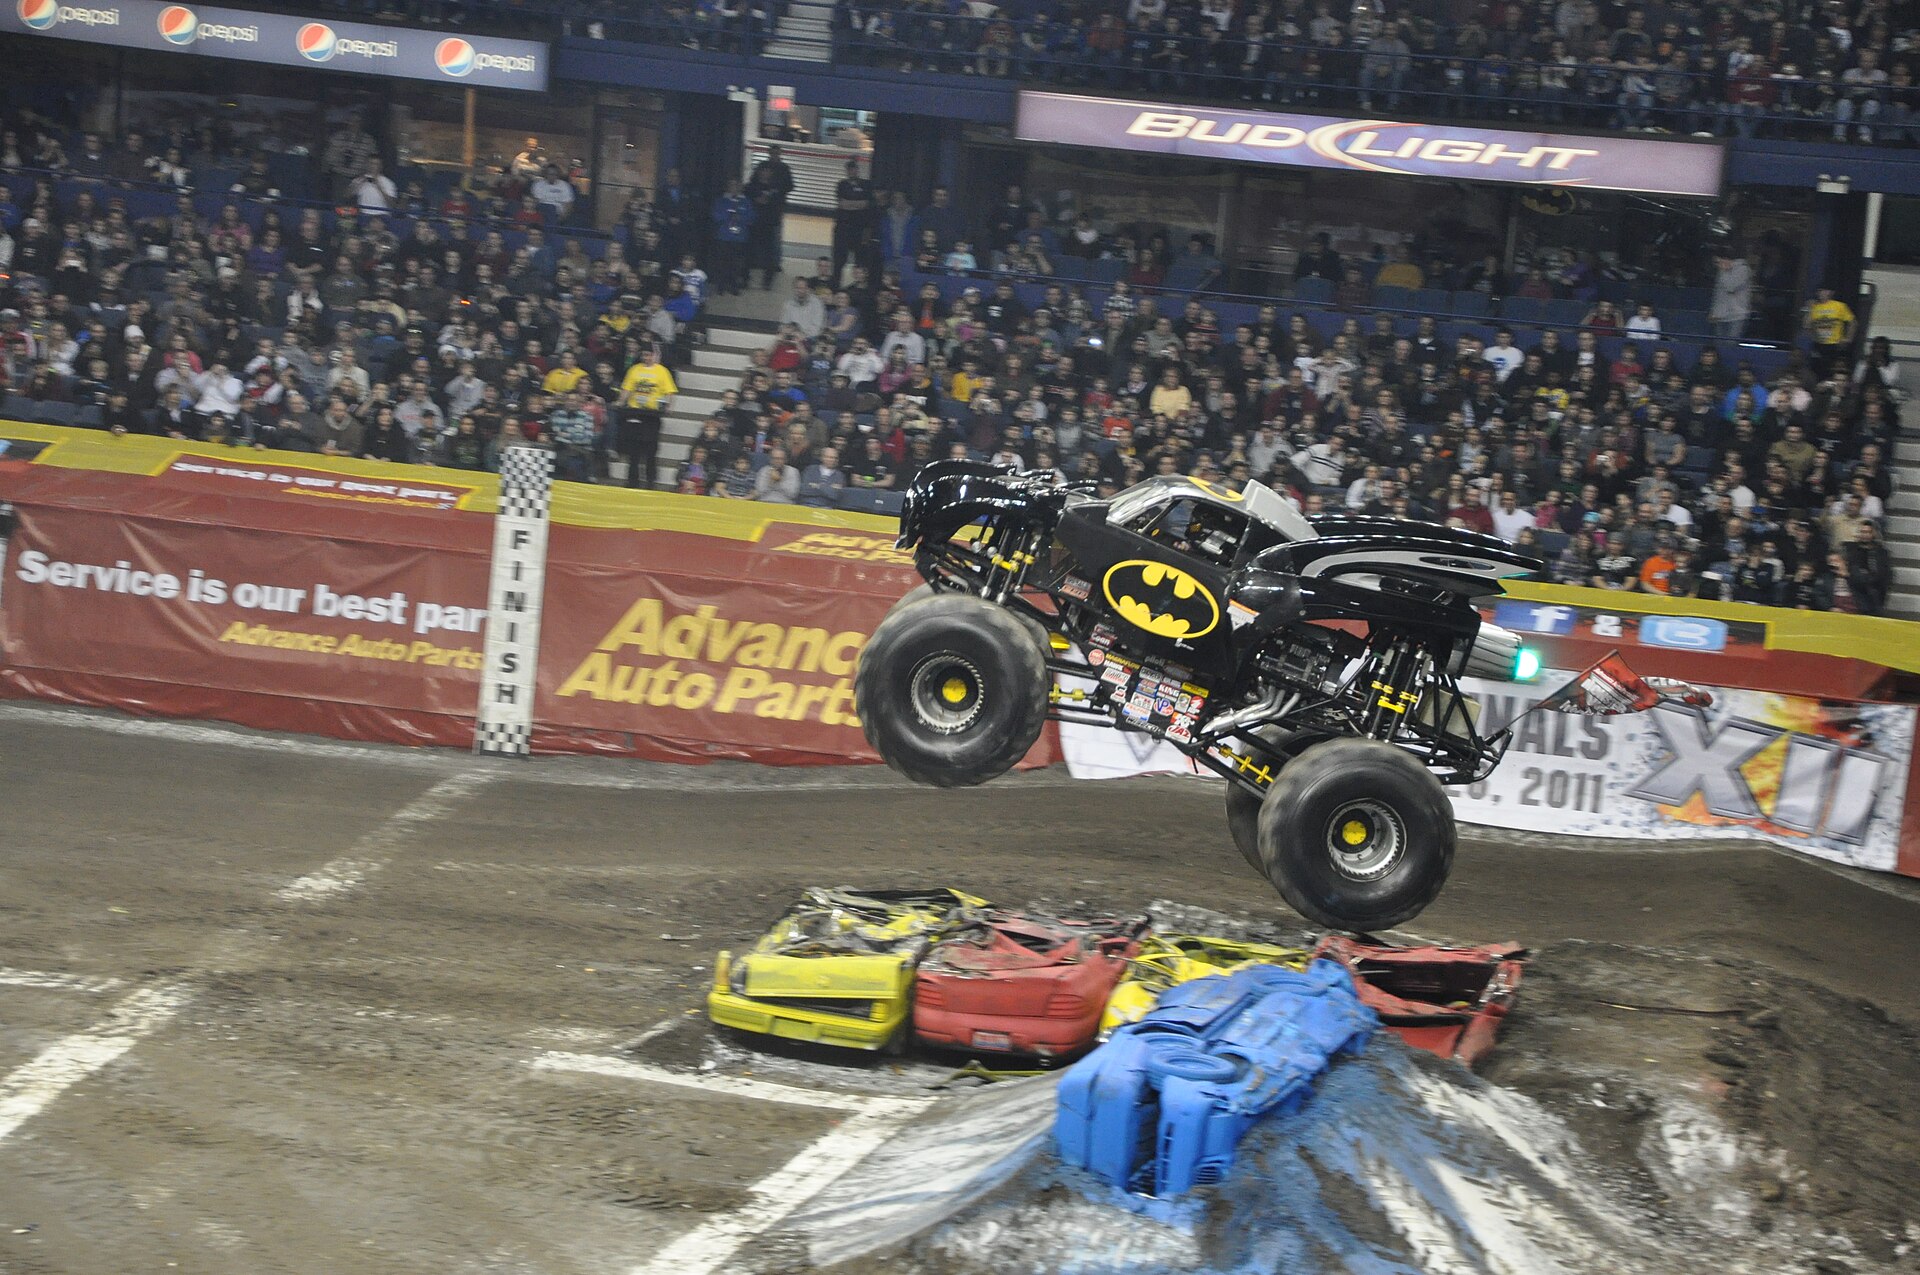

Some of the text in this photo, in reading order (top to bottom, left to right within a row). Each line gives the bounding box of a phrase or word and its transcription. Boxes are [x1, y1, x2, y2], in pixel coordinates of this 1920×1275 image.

[57, 6, 119, 26] pepsi
[197, 23, 259, 43] pepsi
[336, 38, 398, 58] pepsi
[474, 53, 536, 73] pepsi
[16, 550, 181, 598] Service
[187, 569, 228, 605] is
[232, 582, 307, 613] our
[313, 584, 408, 625] best
[496, 529, 530, 705] FINISH
[595, 598, 863, 677] Advanc
[218, 621, 338, 654] Advance
[335, 633, 409, 662] Auto
[554, 652, 717, 710] Auto
[1158, 683, 1180, 697] KING
[1472, 692, 1611, 760] NALS
[1519, 767, 1605, 814] 2011
